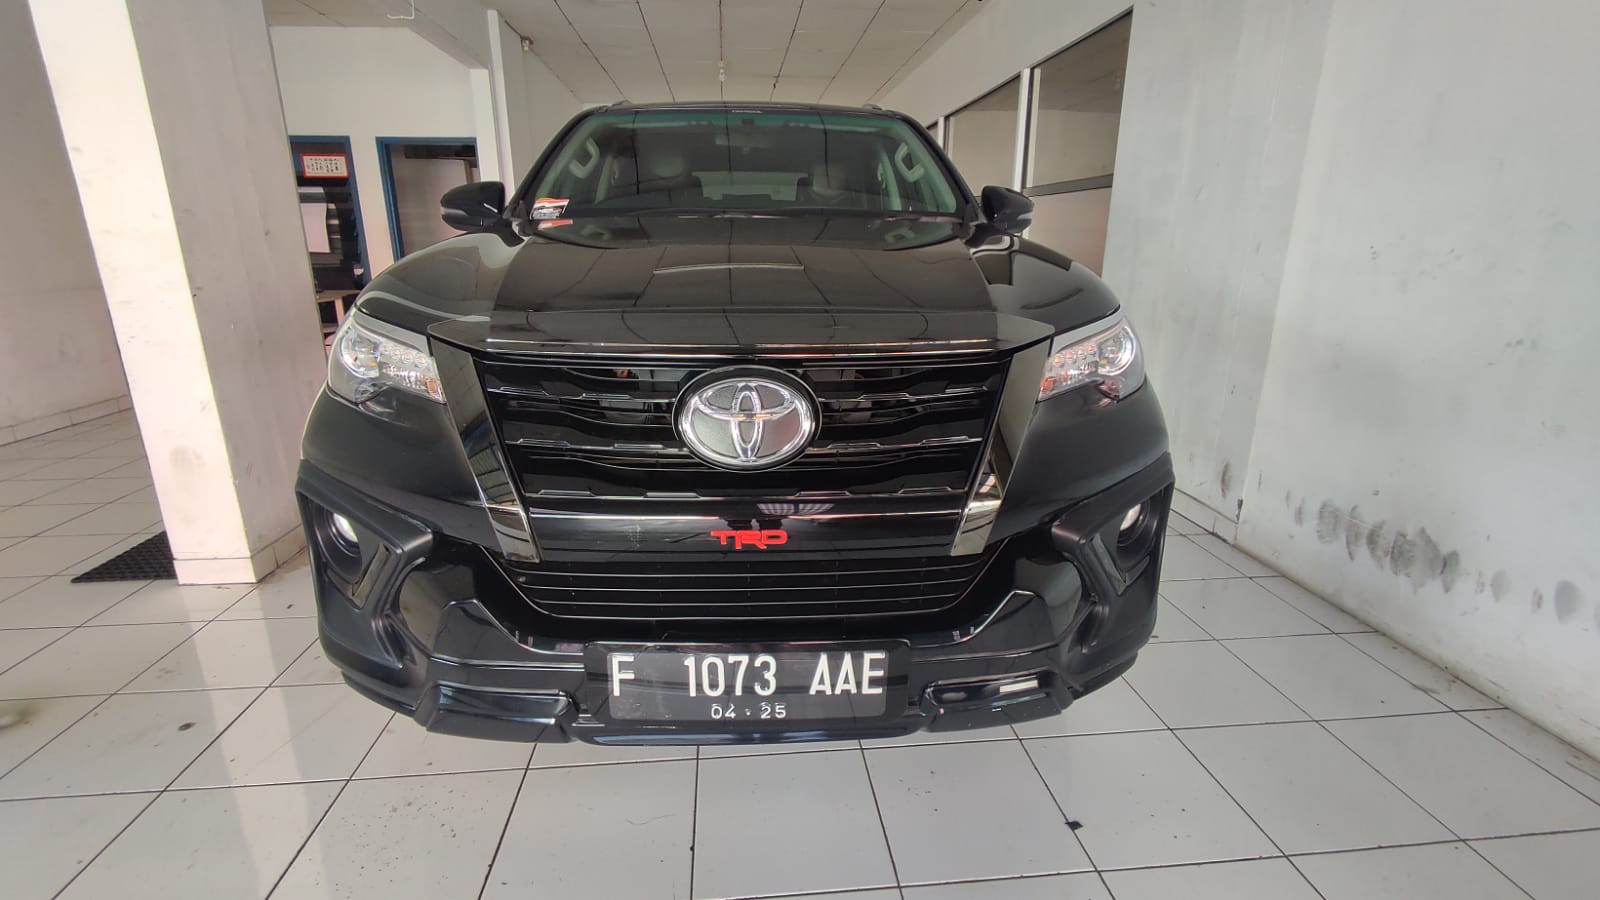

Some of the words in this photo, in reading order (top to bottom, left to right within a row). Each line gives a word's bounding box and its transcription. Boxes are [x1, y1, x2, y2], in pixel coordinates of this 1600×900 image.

[710, 529, 788, 549] TRD
[611, 654, 635, 697] F
[684, 653, 777, 697] 1073
[809, 651, 886, 695] AAE
[711, 704, 737, 719] 04
[760, 703, 786, 719] 25
